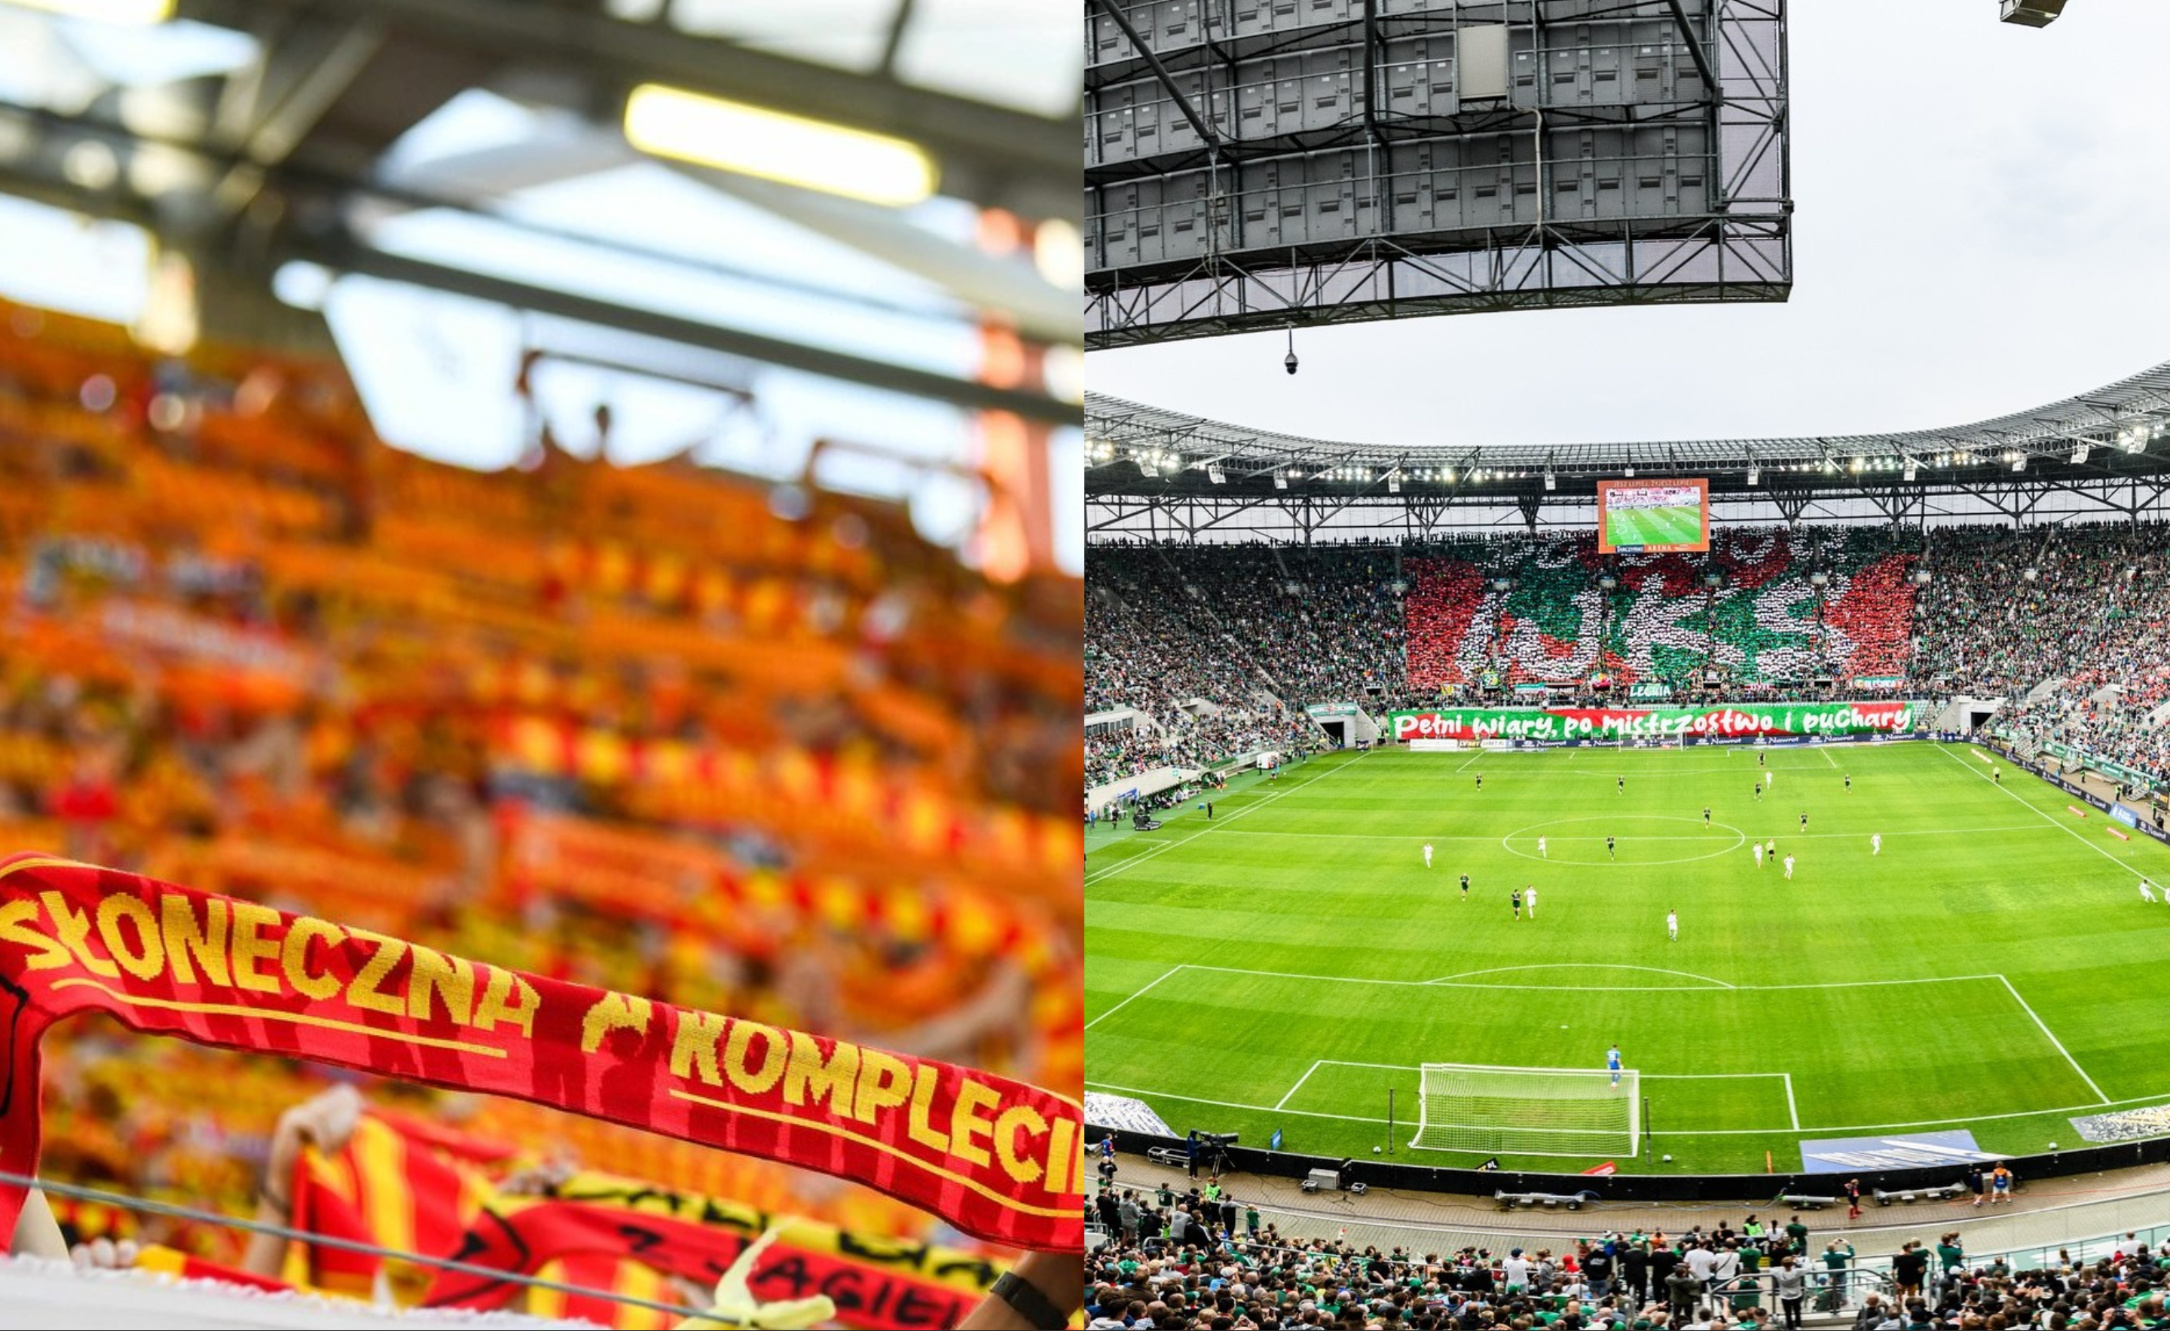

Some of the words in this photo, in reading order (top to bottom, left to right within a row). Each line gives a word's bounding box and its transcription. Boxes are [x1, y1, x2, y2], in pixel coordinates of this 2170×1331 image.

[1564, 715, 1593, 738] po
[1784, 710, 1792, 731] i
[0, 890, 541, 1038] SŁONECZNA
[669, 1010, 1084, 1195] KOMPLECI
